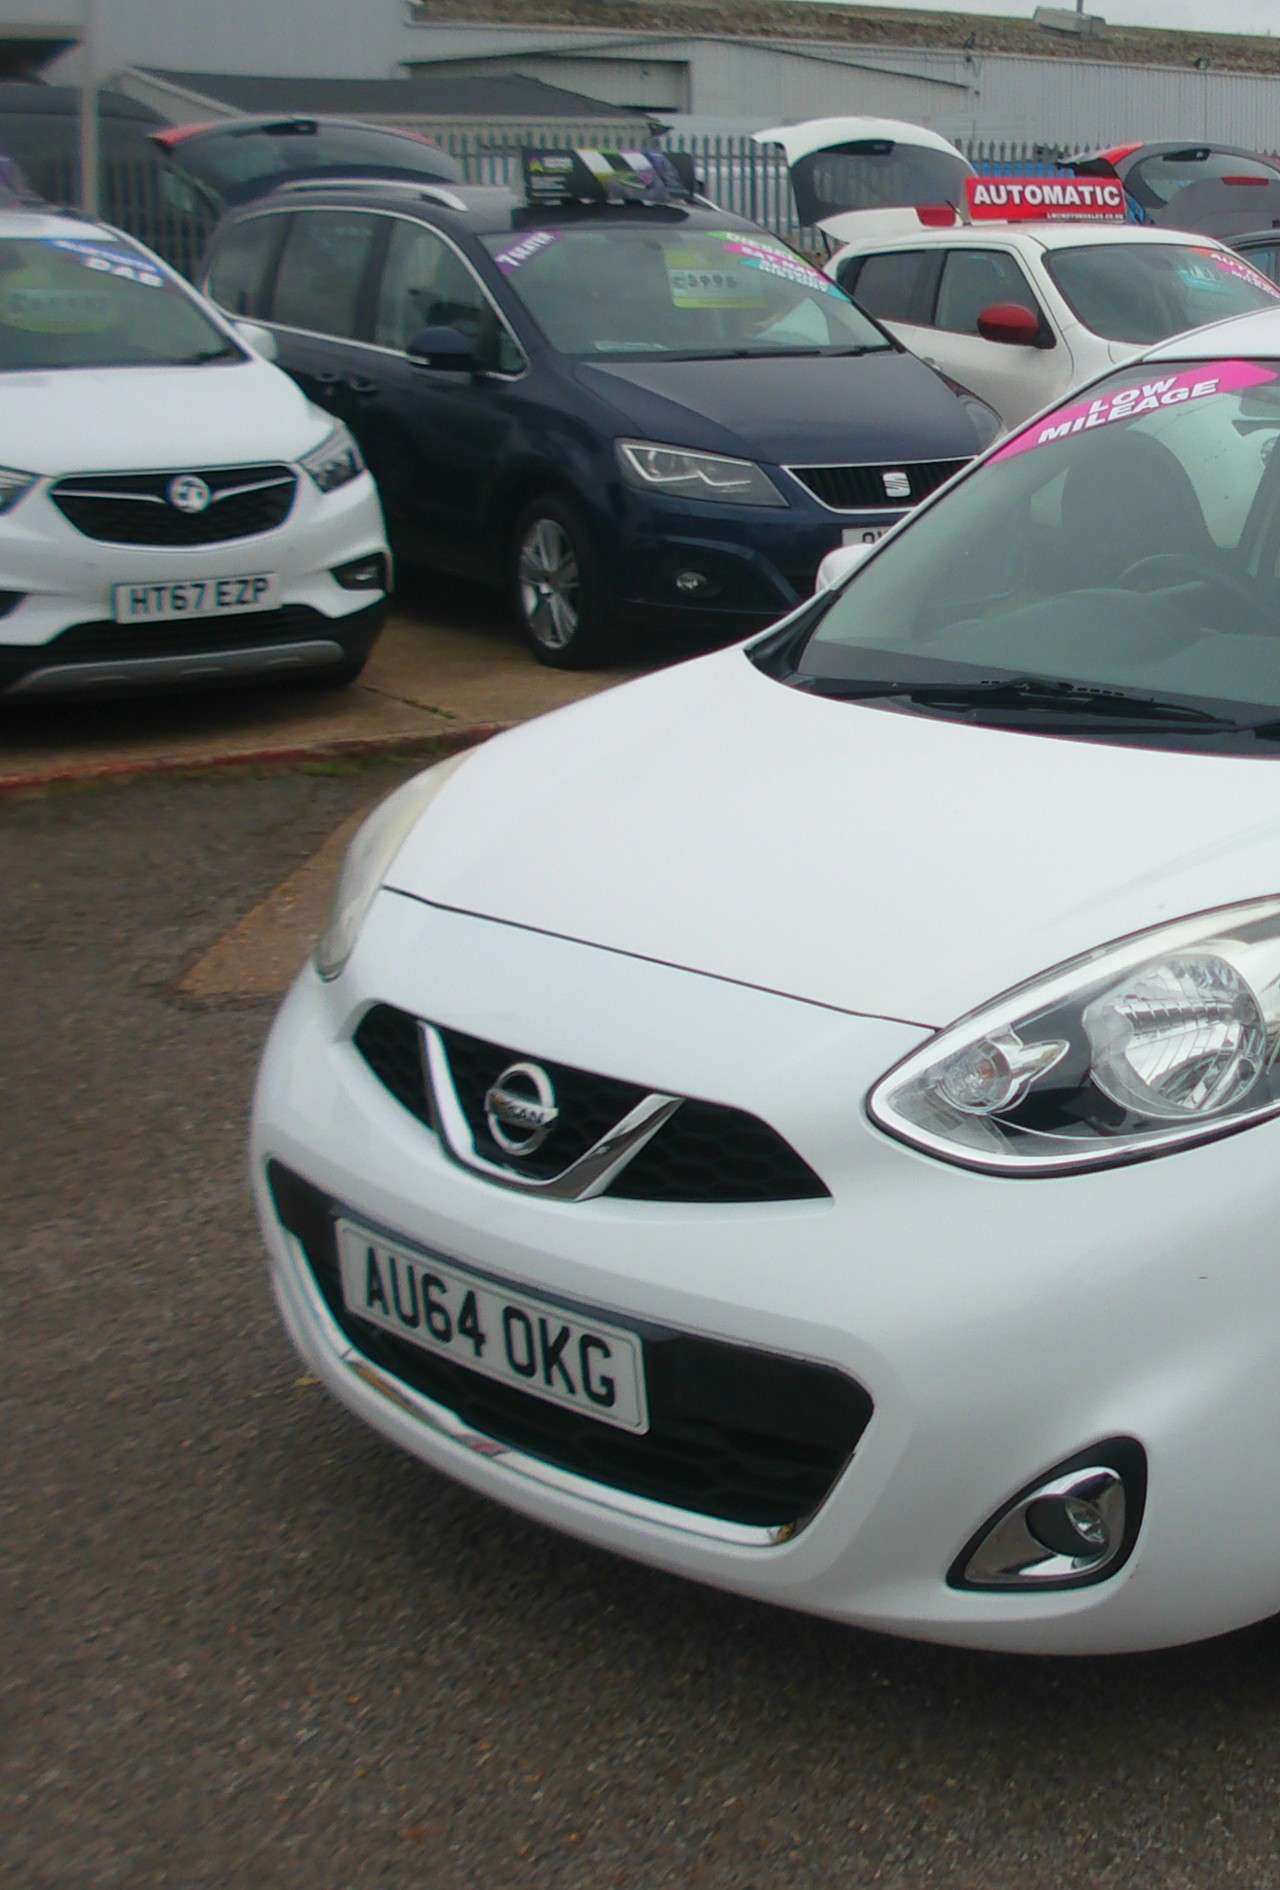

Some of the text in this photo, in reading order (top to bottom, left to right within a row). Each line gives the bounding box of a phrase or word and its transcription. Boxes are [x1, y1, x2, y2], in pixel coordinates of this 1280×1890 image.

[973, 184, 1121, 206] AUTOMATIC
[1037, 378, 1220, 445] MILEAGE
[1088, 376, 1178, 414] LOW
[129, 577, 269, 615] HT67 EZP
[365, 1246, 617, 1408] AU64 OKG
